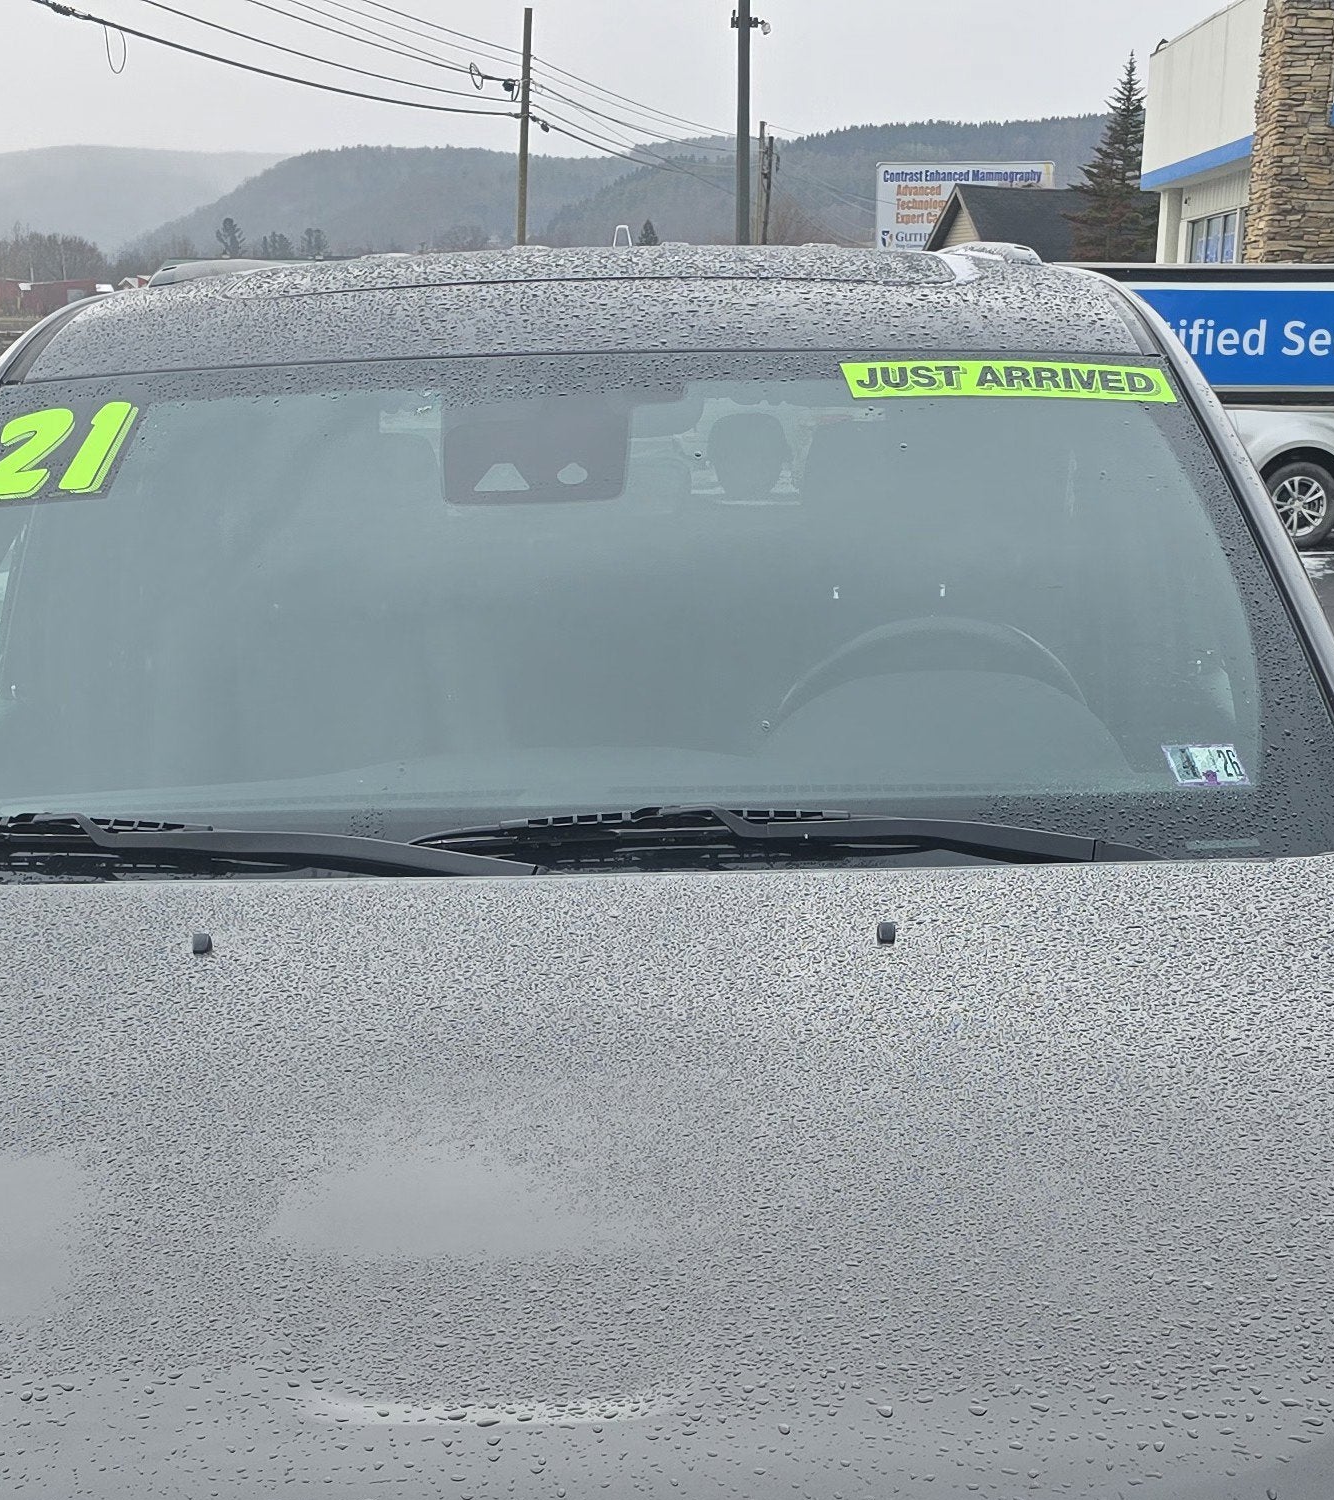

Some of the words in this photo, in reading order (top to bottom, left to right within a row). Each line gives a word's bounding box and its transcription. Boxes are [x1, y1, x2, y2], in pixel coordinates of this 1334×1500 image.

[883, 170, 923, 182] Contrast
[925, 170, 970, 182] Enhanced
[972, 170, 1042, 184] Mammography
[896, 184, 942, 196] Advanced
[895, 198, 948, 211] Technolog
[895, 212, 925, 225] Expert
[926, 211, 939, 224] Ca
[895, 231, 931, 243] GUTH
[1166, 319, 1267, 356] ified
[856, 364, 966, 392] JUST
[976, 365, 1162, 395] ARRIVED
[1216, 749, 1244, 777] 26
